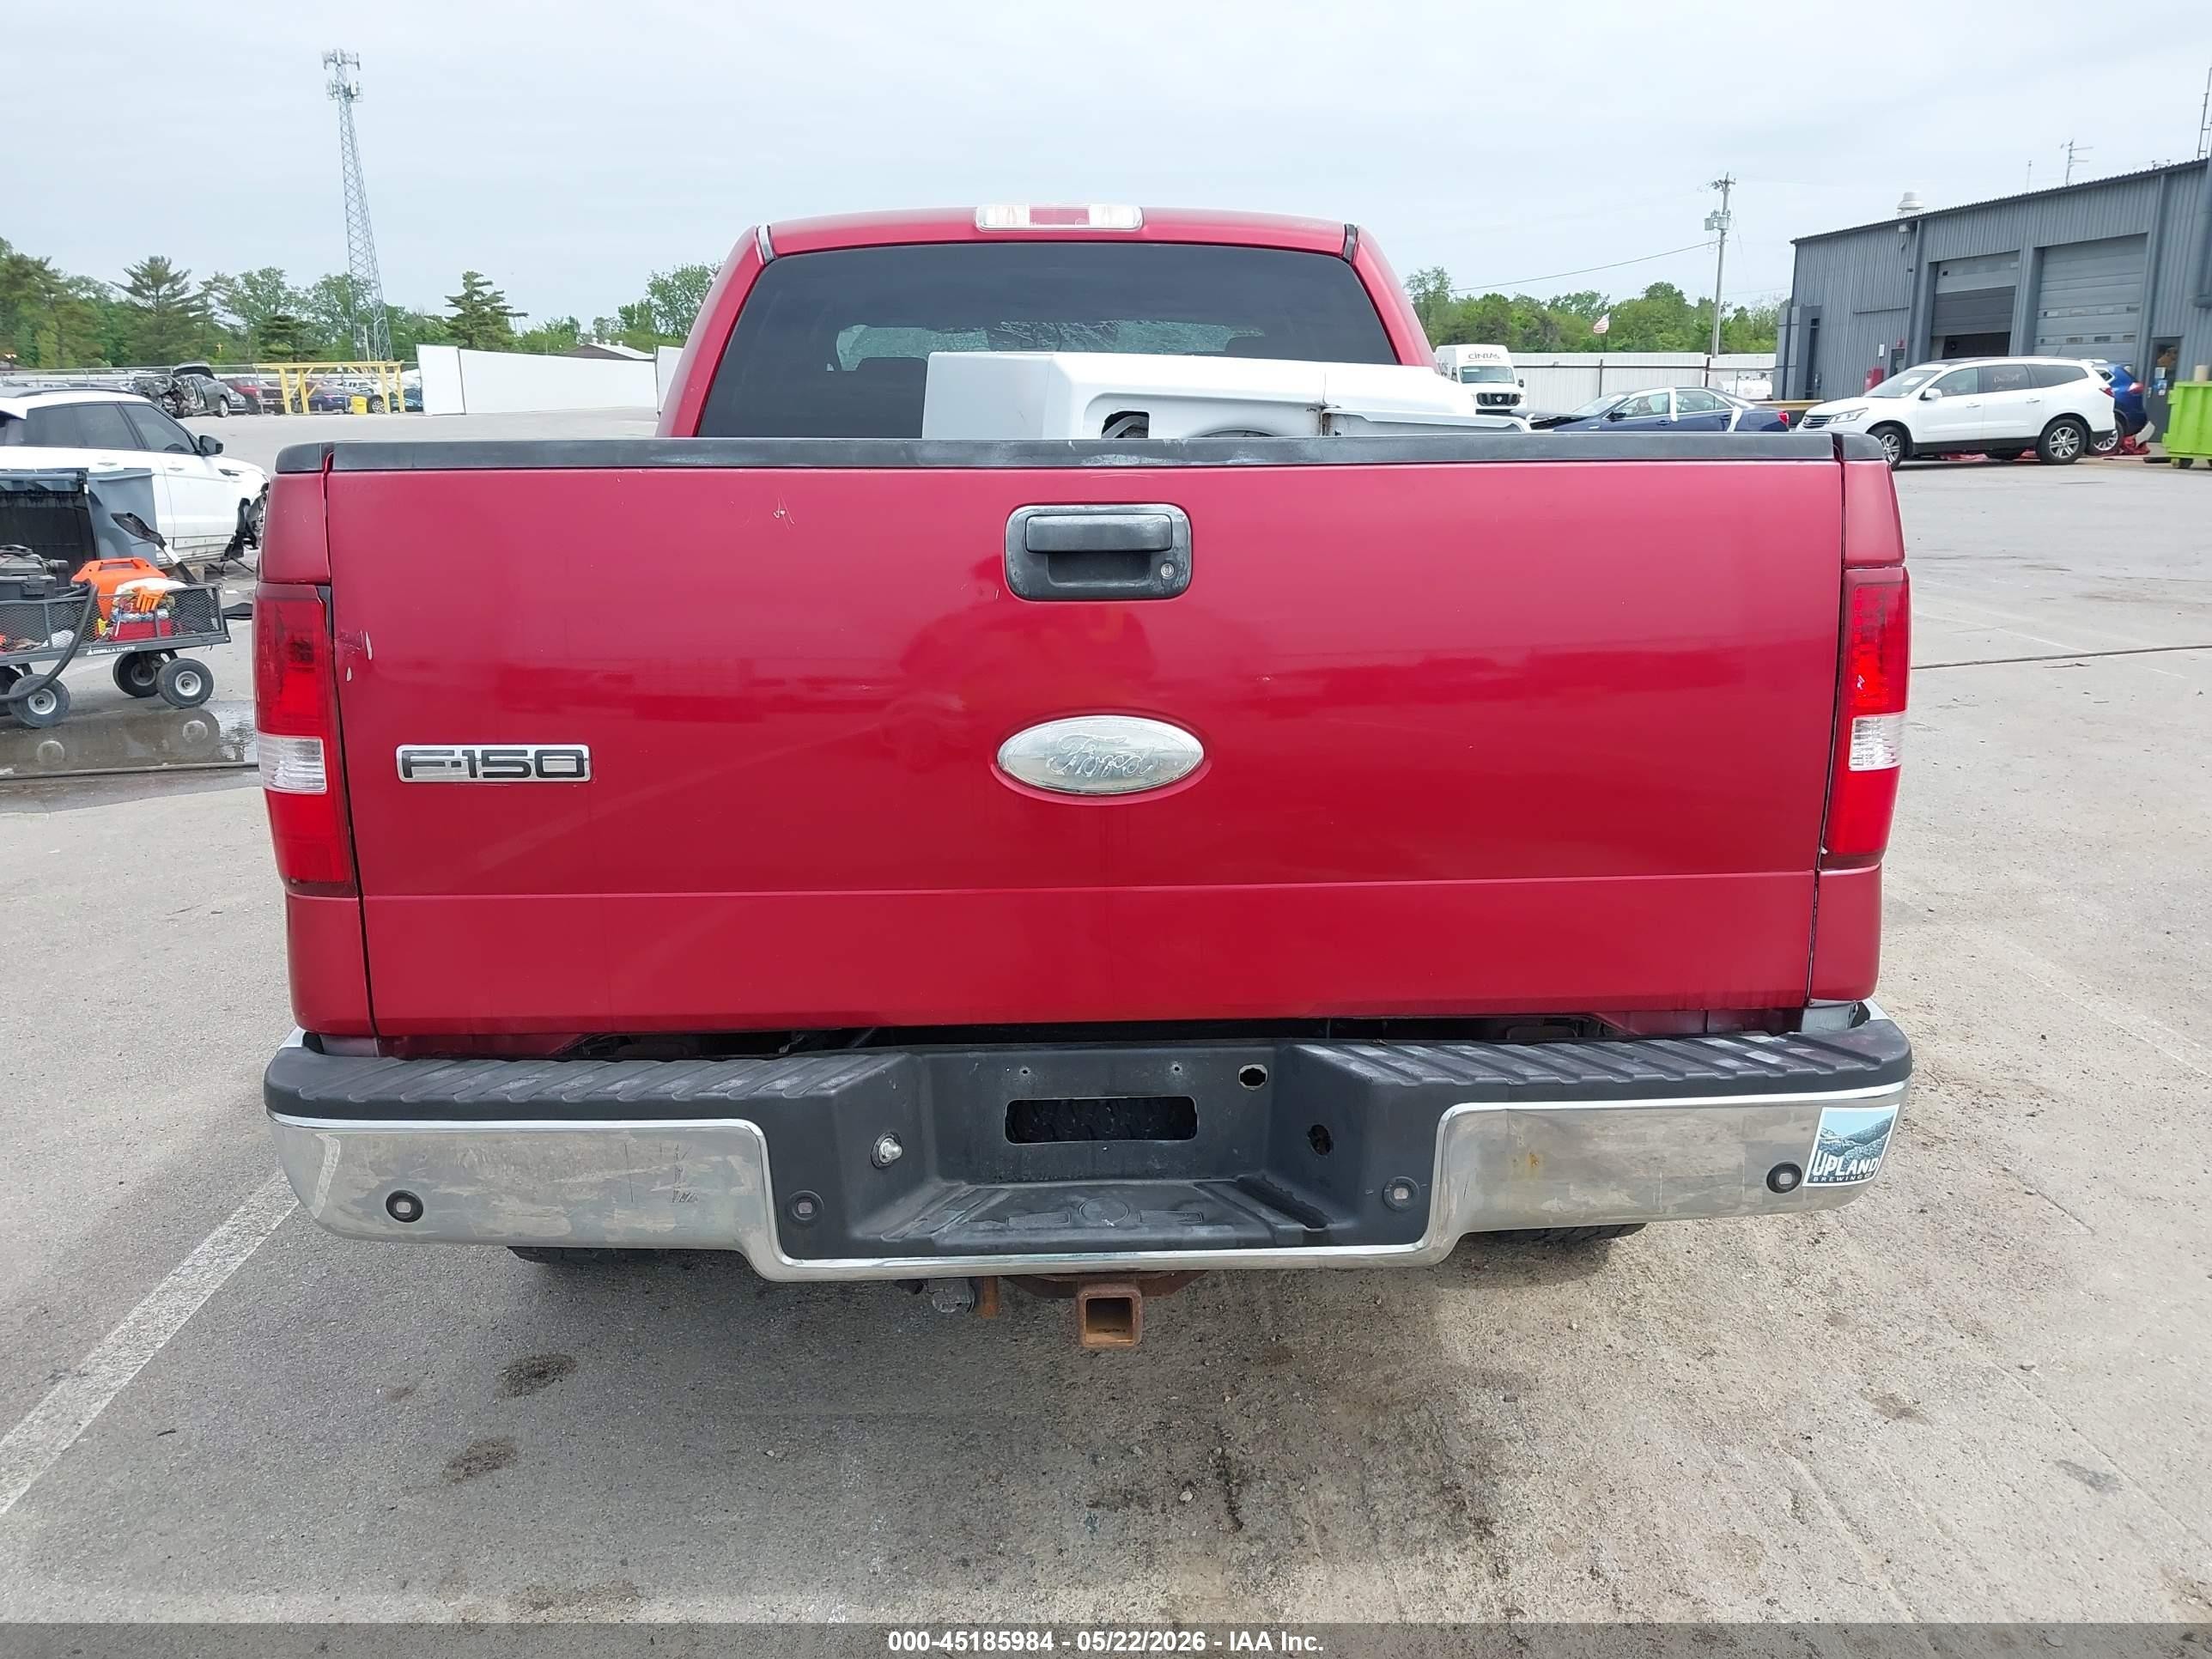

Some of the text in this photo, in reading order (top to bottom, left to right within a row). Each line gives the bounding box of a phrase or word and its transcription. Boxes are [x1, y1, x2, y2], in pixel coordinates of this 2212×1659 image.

[401, 749, 586, 779] F-150
[1812, 1149, 1880, 1176] UPLAND
[1813, 1174, 1863, 1182] BREWING
